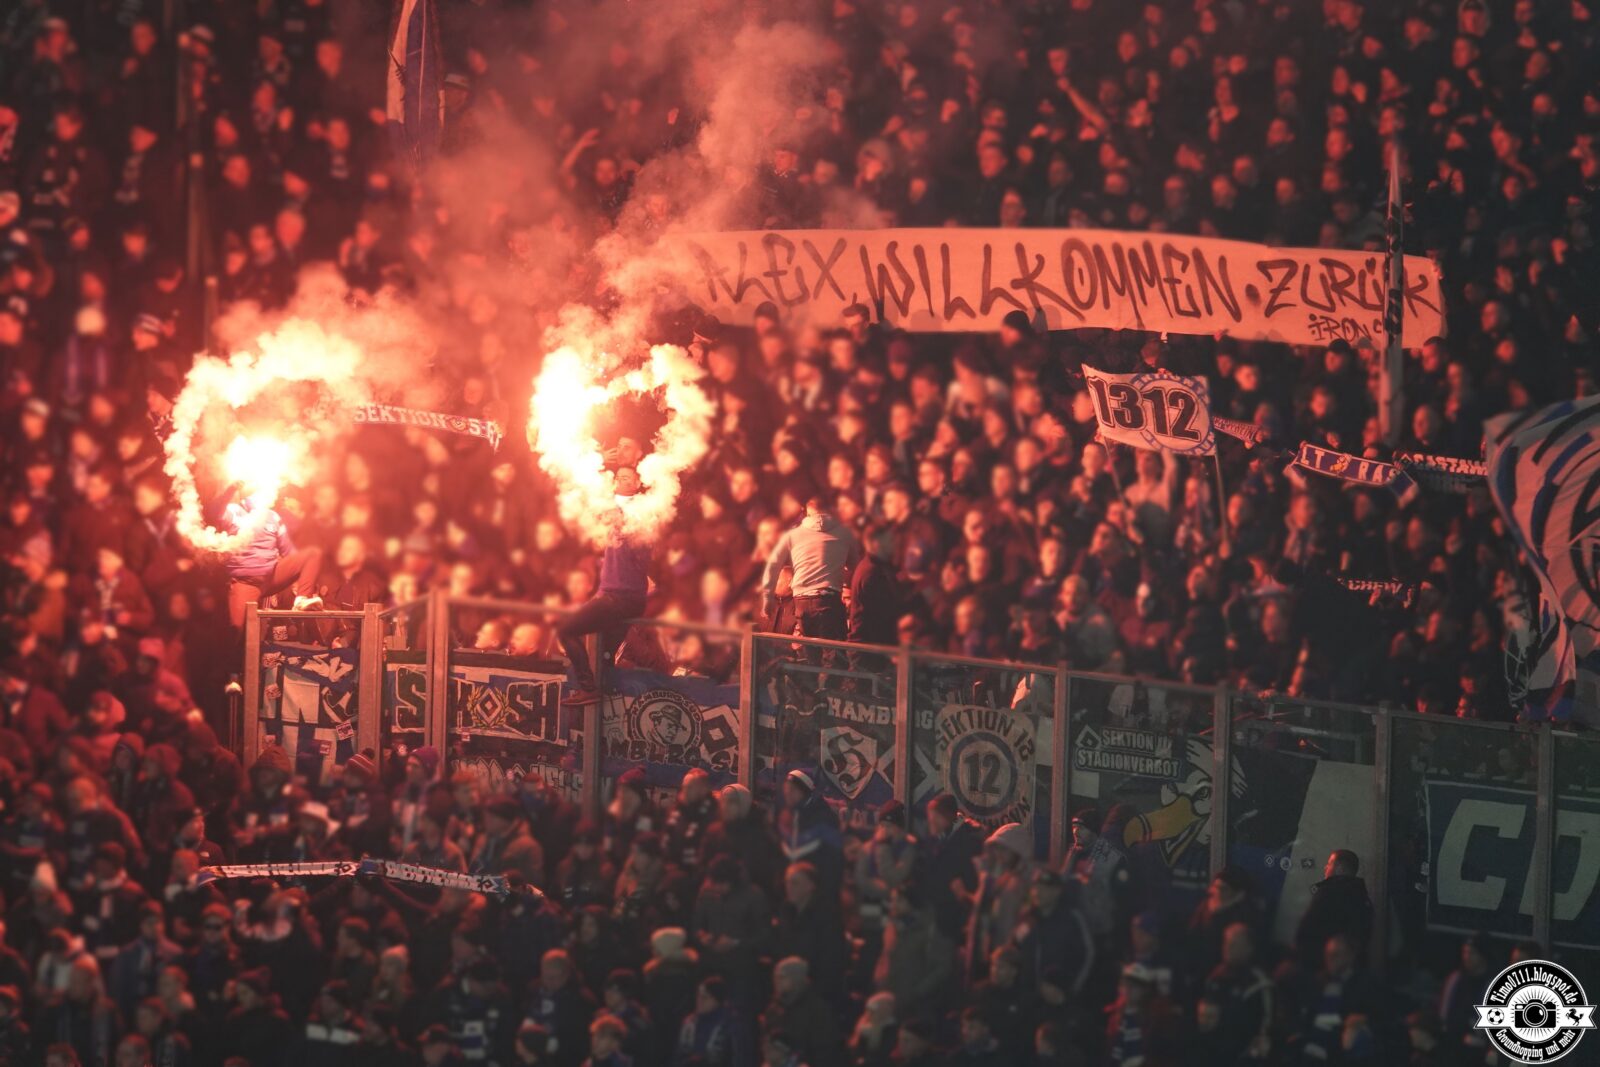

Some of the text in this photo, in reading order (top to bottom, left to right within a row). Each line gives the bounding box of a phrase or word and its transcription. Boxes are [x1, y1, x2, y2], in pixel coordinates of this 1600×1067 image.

[1256, 257, 1443, 319] ZURÜK
[353, 403, 447, 429] SEKTION
[1087, 376, 1201, 442] 1312
[935, 709, 1035, 762] SEKTION 12
[1102, 730, 1154, 750] SEKTION
[964, 752, 1001, 795] 12
[1077, 750, 1179, 778] STADIONVERBOT
